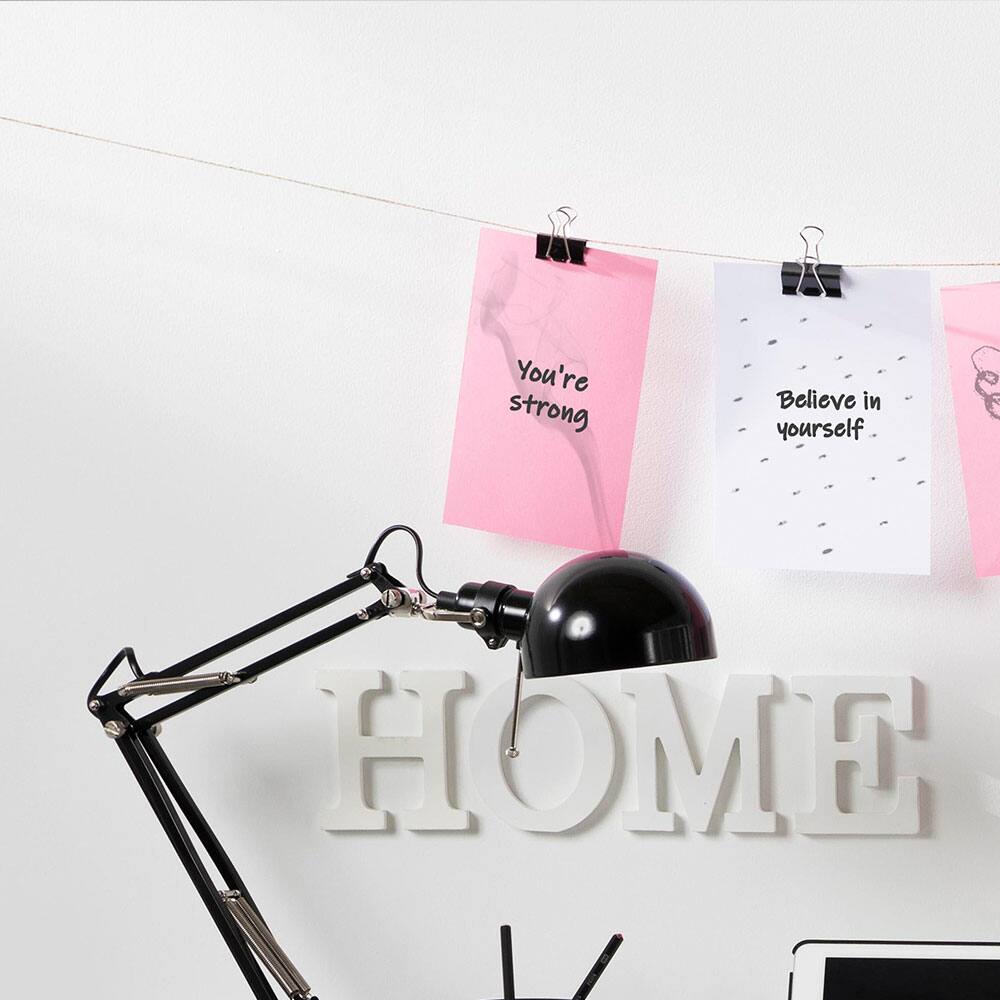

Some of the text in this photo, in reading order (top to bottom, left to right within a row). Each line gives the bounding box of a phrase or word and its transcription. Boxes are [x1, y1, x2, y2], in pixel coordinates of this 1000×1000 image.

[517, 359, 589, 392] You're
[509, 394, 589, 433] strong
[776, 389, 881, 411] Believe in
[777, 417, 865, 441] yourself
[315, 669, 920, 834] HOME
